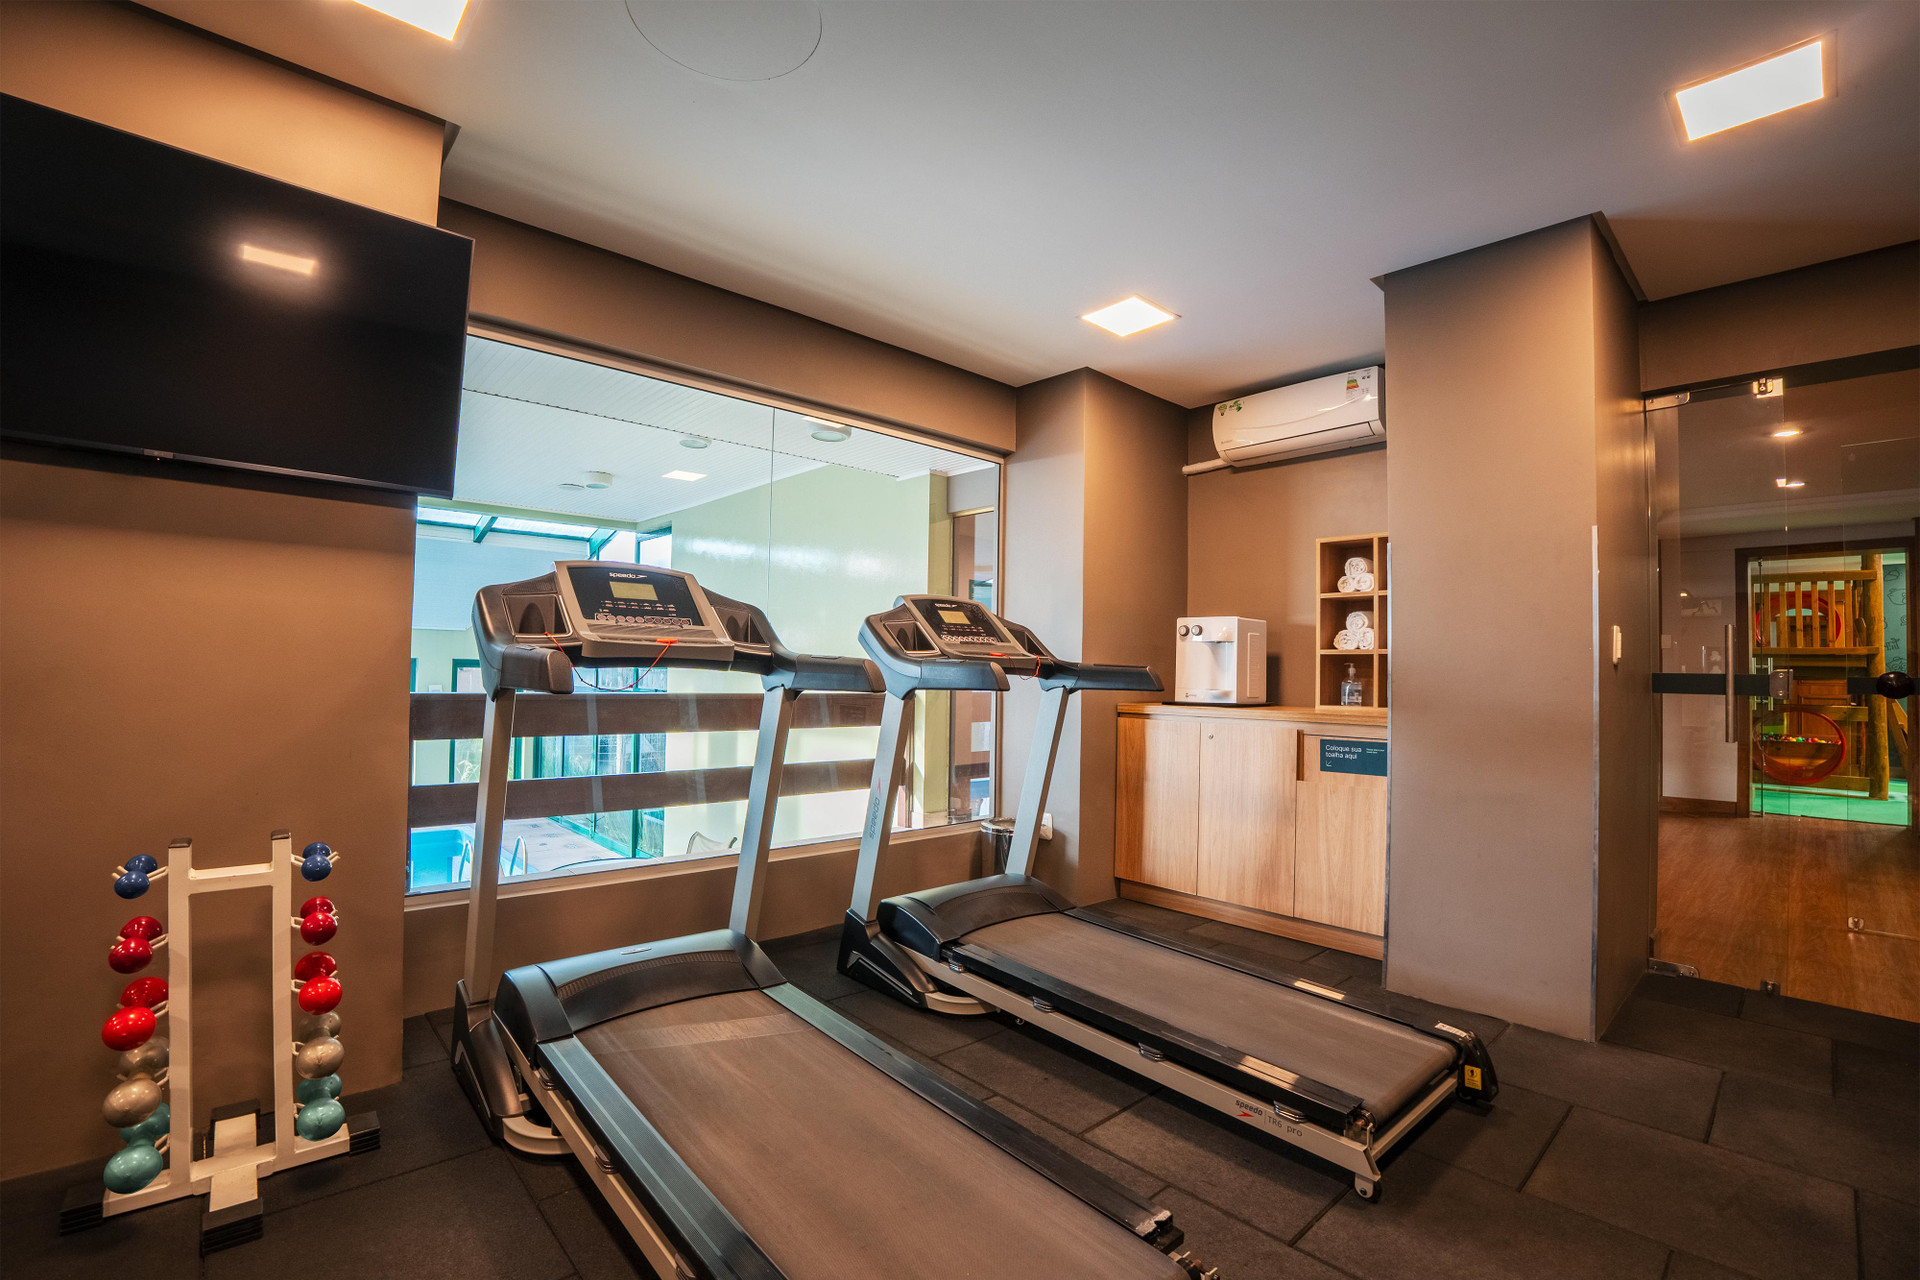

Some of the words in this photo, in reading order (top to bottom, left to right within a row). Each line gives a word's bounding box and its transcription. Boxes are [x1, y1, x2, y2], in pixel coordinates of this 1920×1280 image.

[1325, 744, 1349, 753] Coloque
[1325, 751, 1343, 759] toalha
[1344, 753, 1358, 761] aqui
[868, 797, 881, 840] speedo
[1235, 1098, 1263, 1116] speedo
[1267, 1115, 1283, 1128] TR6
[1286, 1124, 1303, 1137] pro
